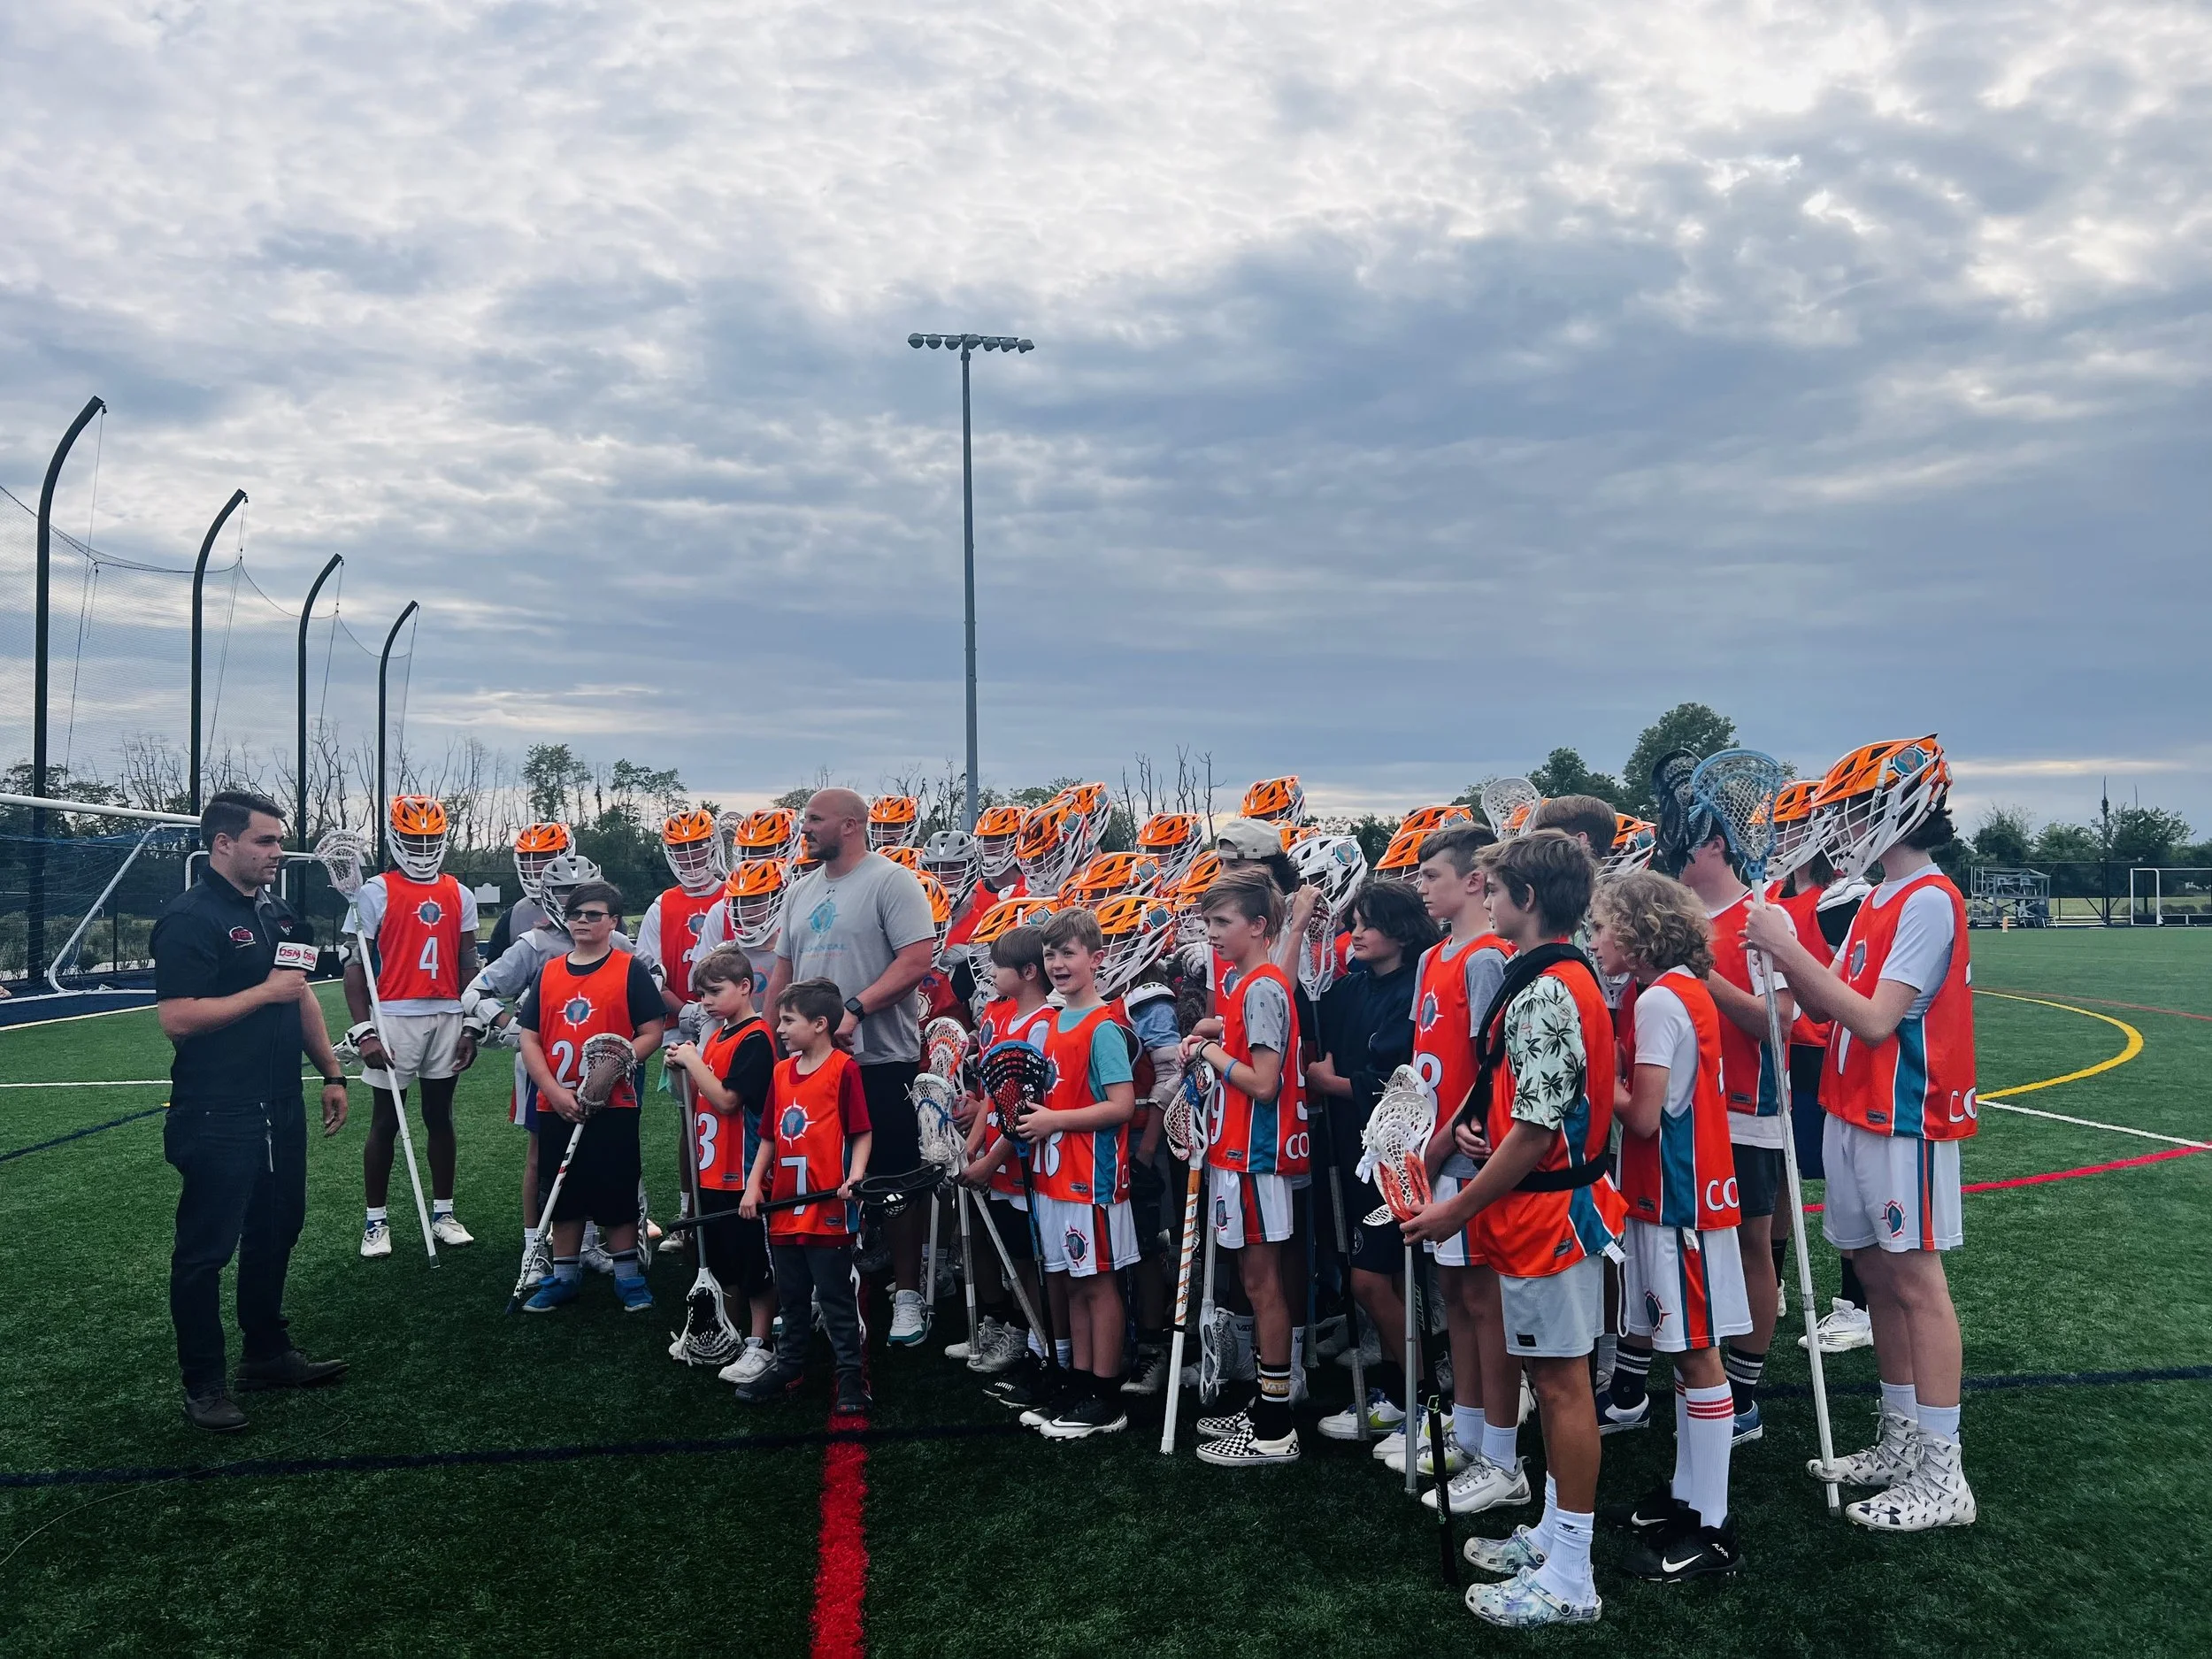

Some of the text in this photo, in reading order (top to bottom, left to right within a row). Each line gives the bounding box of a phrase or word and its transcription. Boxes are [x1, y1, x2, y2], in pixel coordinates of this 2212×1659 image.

[419, 935, 440, 979] 4
[780, 1156, 807, 1216] 7
[1705, 1177, 1740, 1211] CO
